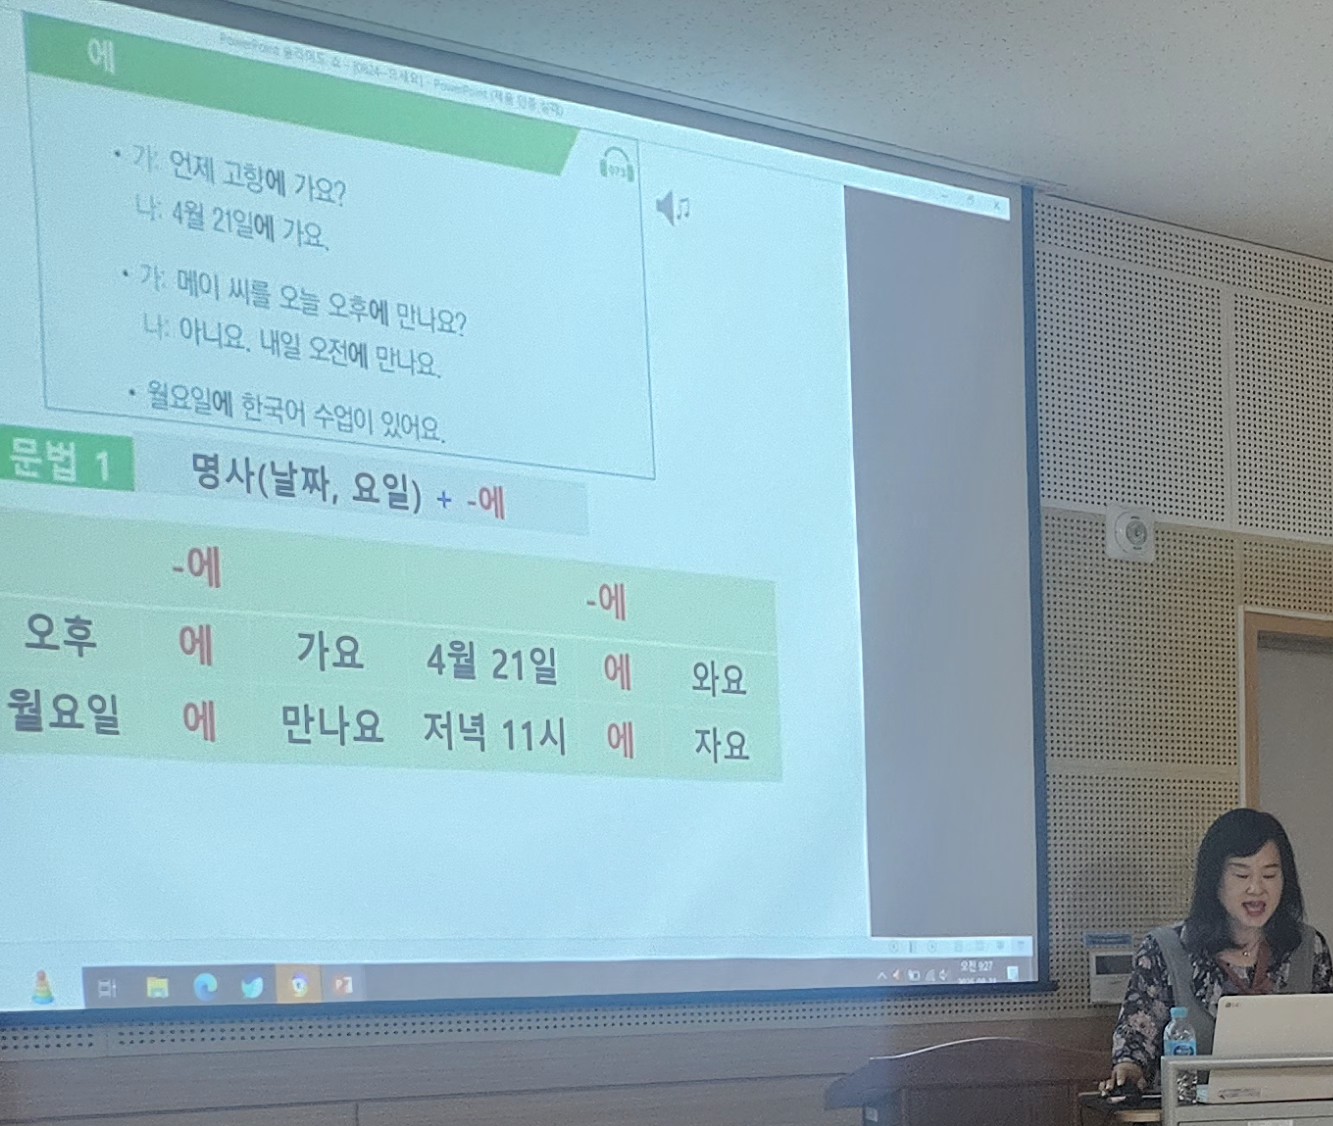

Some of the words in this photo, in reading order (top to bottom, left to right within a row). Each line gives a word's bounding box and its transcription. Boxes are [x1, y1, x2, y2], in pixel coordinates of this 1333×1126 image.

[87, 37, 115, 75] 에
[133, 144, 159, 172] 가:
[170, 150, 215, 184] 언제
[223, 160, 286, 197] 고향에
[295, 173, 347, 207] 가요?
[136, 193, 162, 221] 나:
[172, 200, 205, 232] 4월
[212, 207, 275, 243] 21일에
[283, 218, 329, 251] 가요.
[140, 263, 166, 291] 가:
[177, 269, 220, 301] 메이
[229, 276, 271, 309] 씨를
[280, 284, 320, 316] 오늘
[328, 292, 389, 327] 오후에
[397, 302, 467, 337] 만나요?
[143, 313, 170, 341] 나:
[180, 316, 251, 352] 아니요.
[260, 327, 301, 361] 내일
[309, 336, 368, 369] 오전에
[376, 345, 442, 378] 만나요.
[147, 379, 233, 418] 월요일에
[241, 391, 306, 427] 한국어
[313, 402, 373, 435] 수업이
[381, 410, 446, 444] 있어요.
[10, 437, 77, 483] 문법
[96, 451, 110, 482] 1
[192, 452, 338, 505] 명사(날짜,
[352, 471, 422, 515] 요일)
[467, 485, 506, 521] -에
[172, 545, 222, 589] -에
[586, 583, 627, 622] -에
[25, 612, 97, 658] 오후
[179, 623, 213, 667] 에
[297, 630, 365, 672] 가요
[426, 640, 477, 680] 4월
[492, 647, 557, 686] 21일
[604, 652, 632, 691] 에
[692, 660, 748, 698] 와요
[7, 688, 120, 736] 월요일
[182, 700, 216, 743] 에
[282, 704, 384, 746] 만나요
[424, 711, 486, 752] 저녁
[502, 717, 566, 757] 11시
[607, 721, 634, 760] 에
[694, 726, 750, 764] 자요
